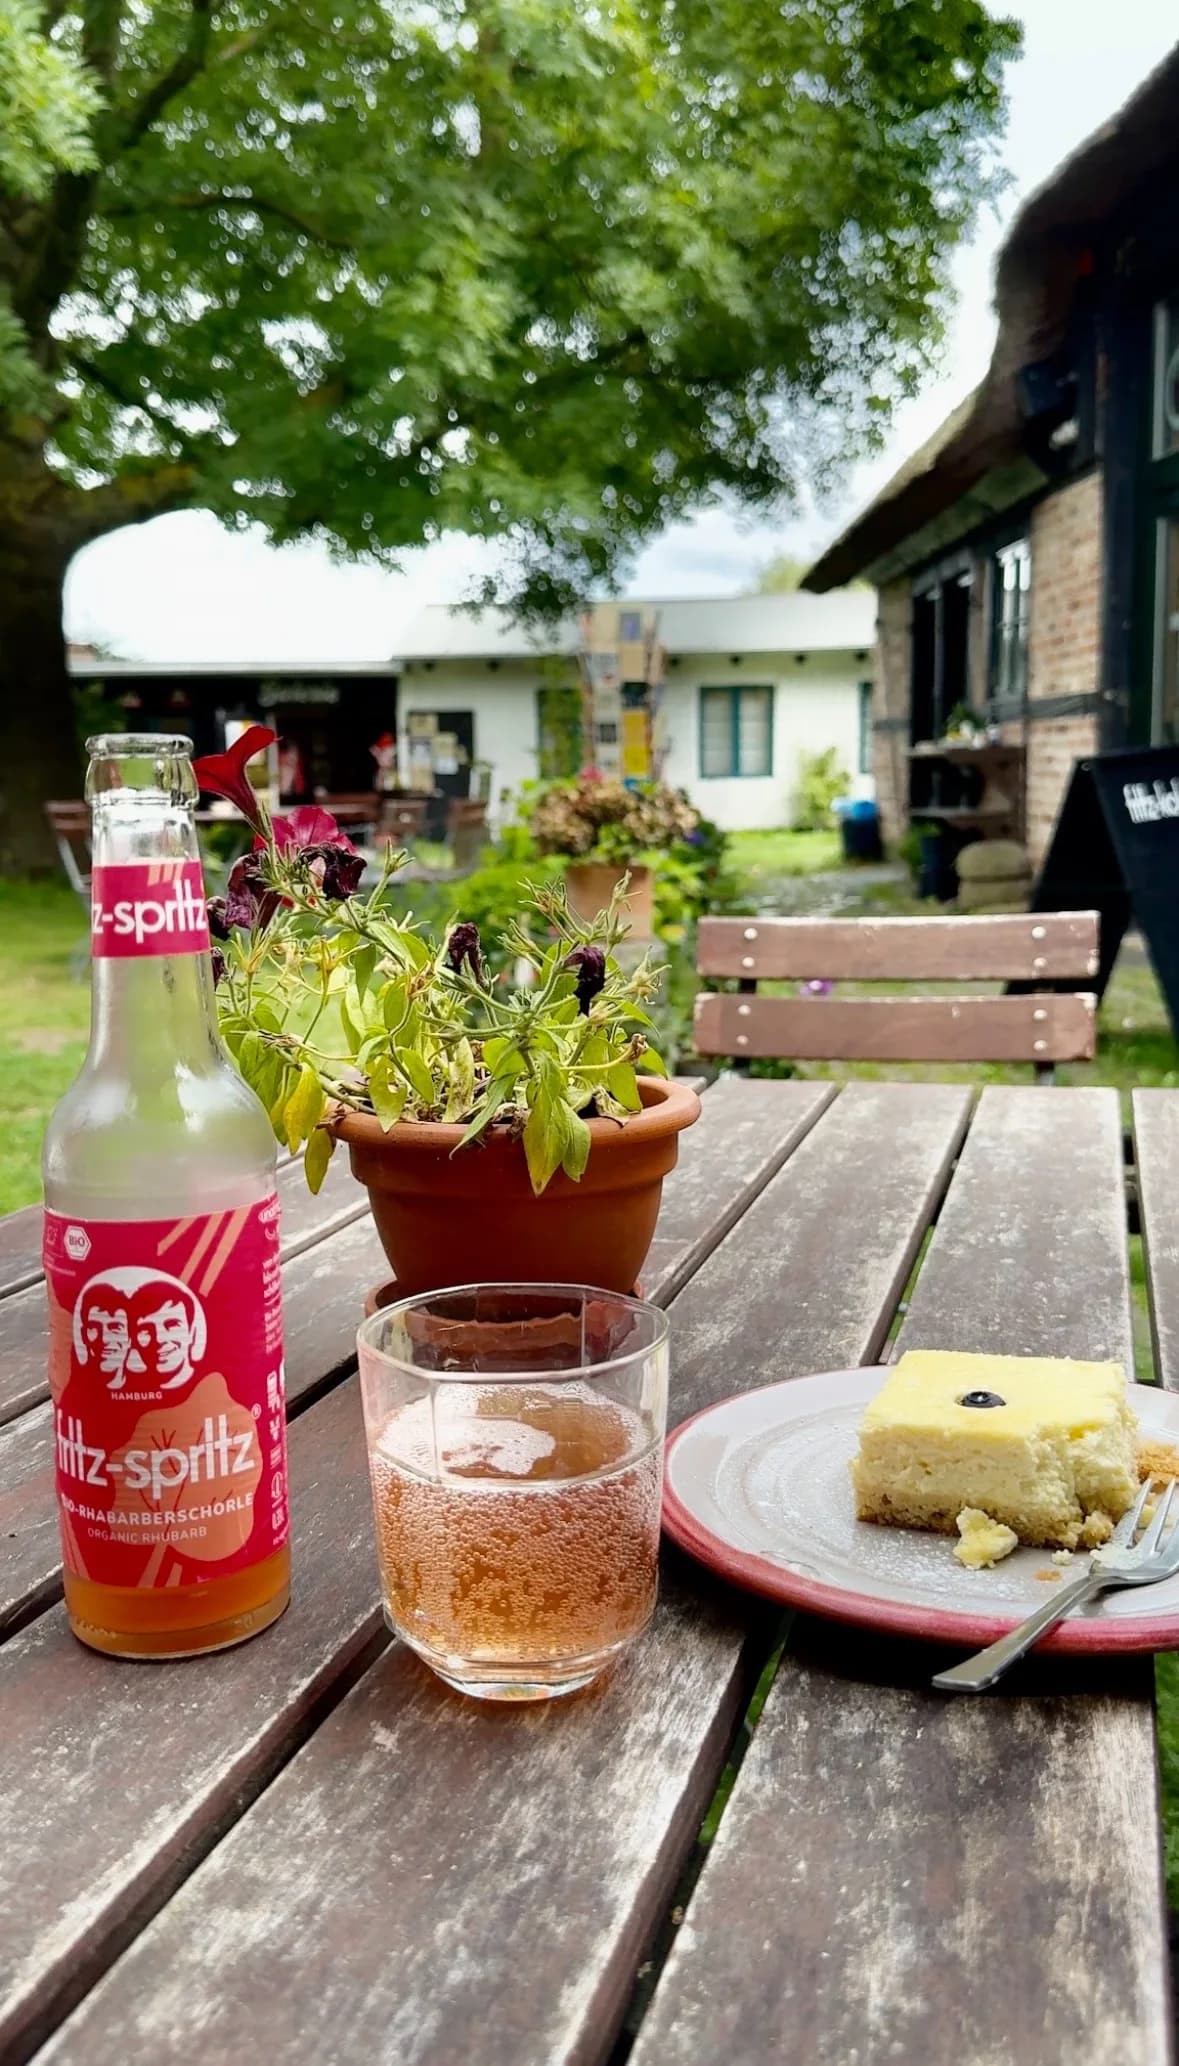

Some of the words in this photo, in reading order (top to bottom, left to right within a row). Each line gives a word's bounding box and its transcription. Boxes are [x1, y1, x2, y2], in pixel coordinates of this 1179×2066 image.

[110, 1390, 163, 1401] HAMBURG
[87, 1527, 139, 1545] ORGANIC
[141, 1526, 207, 1544] RHUBARB
